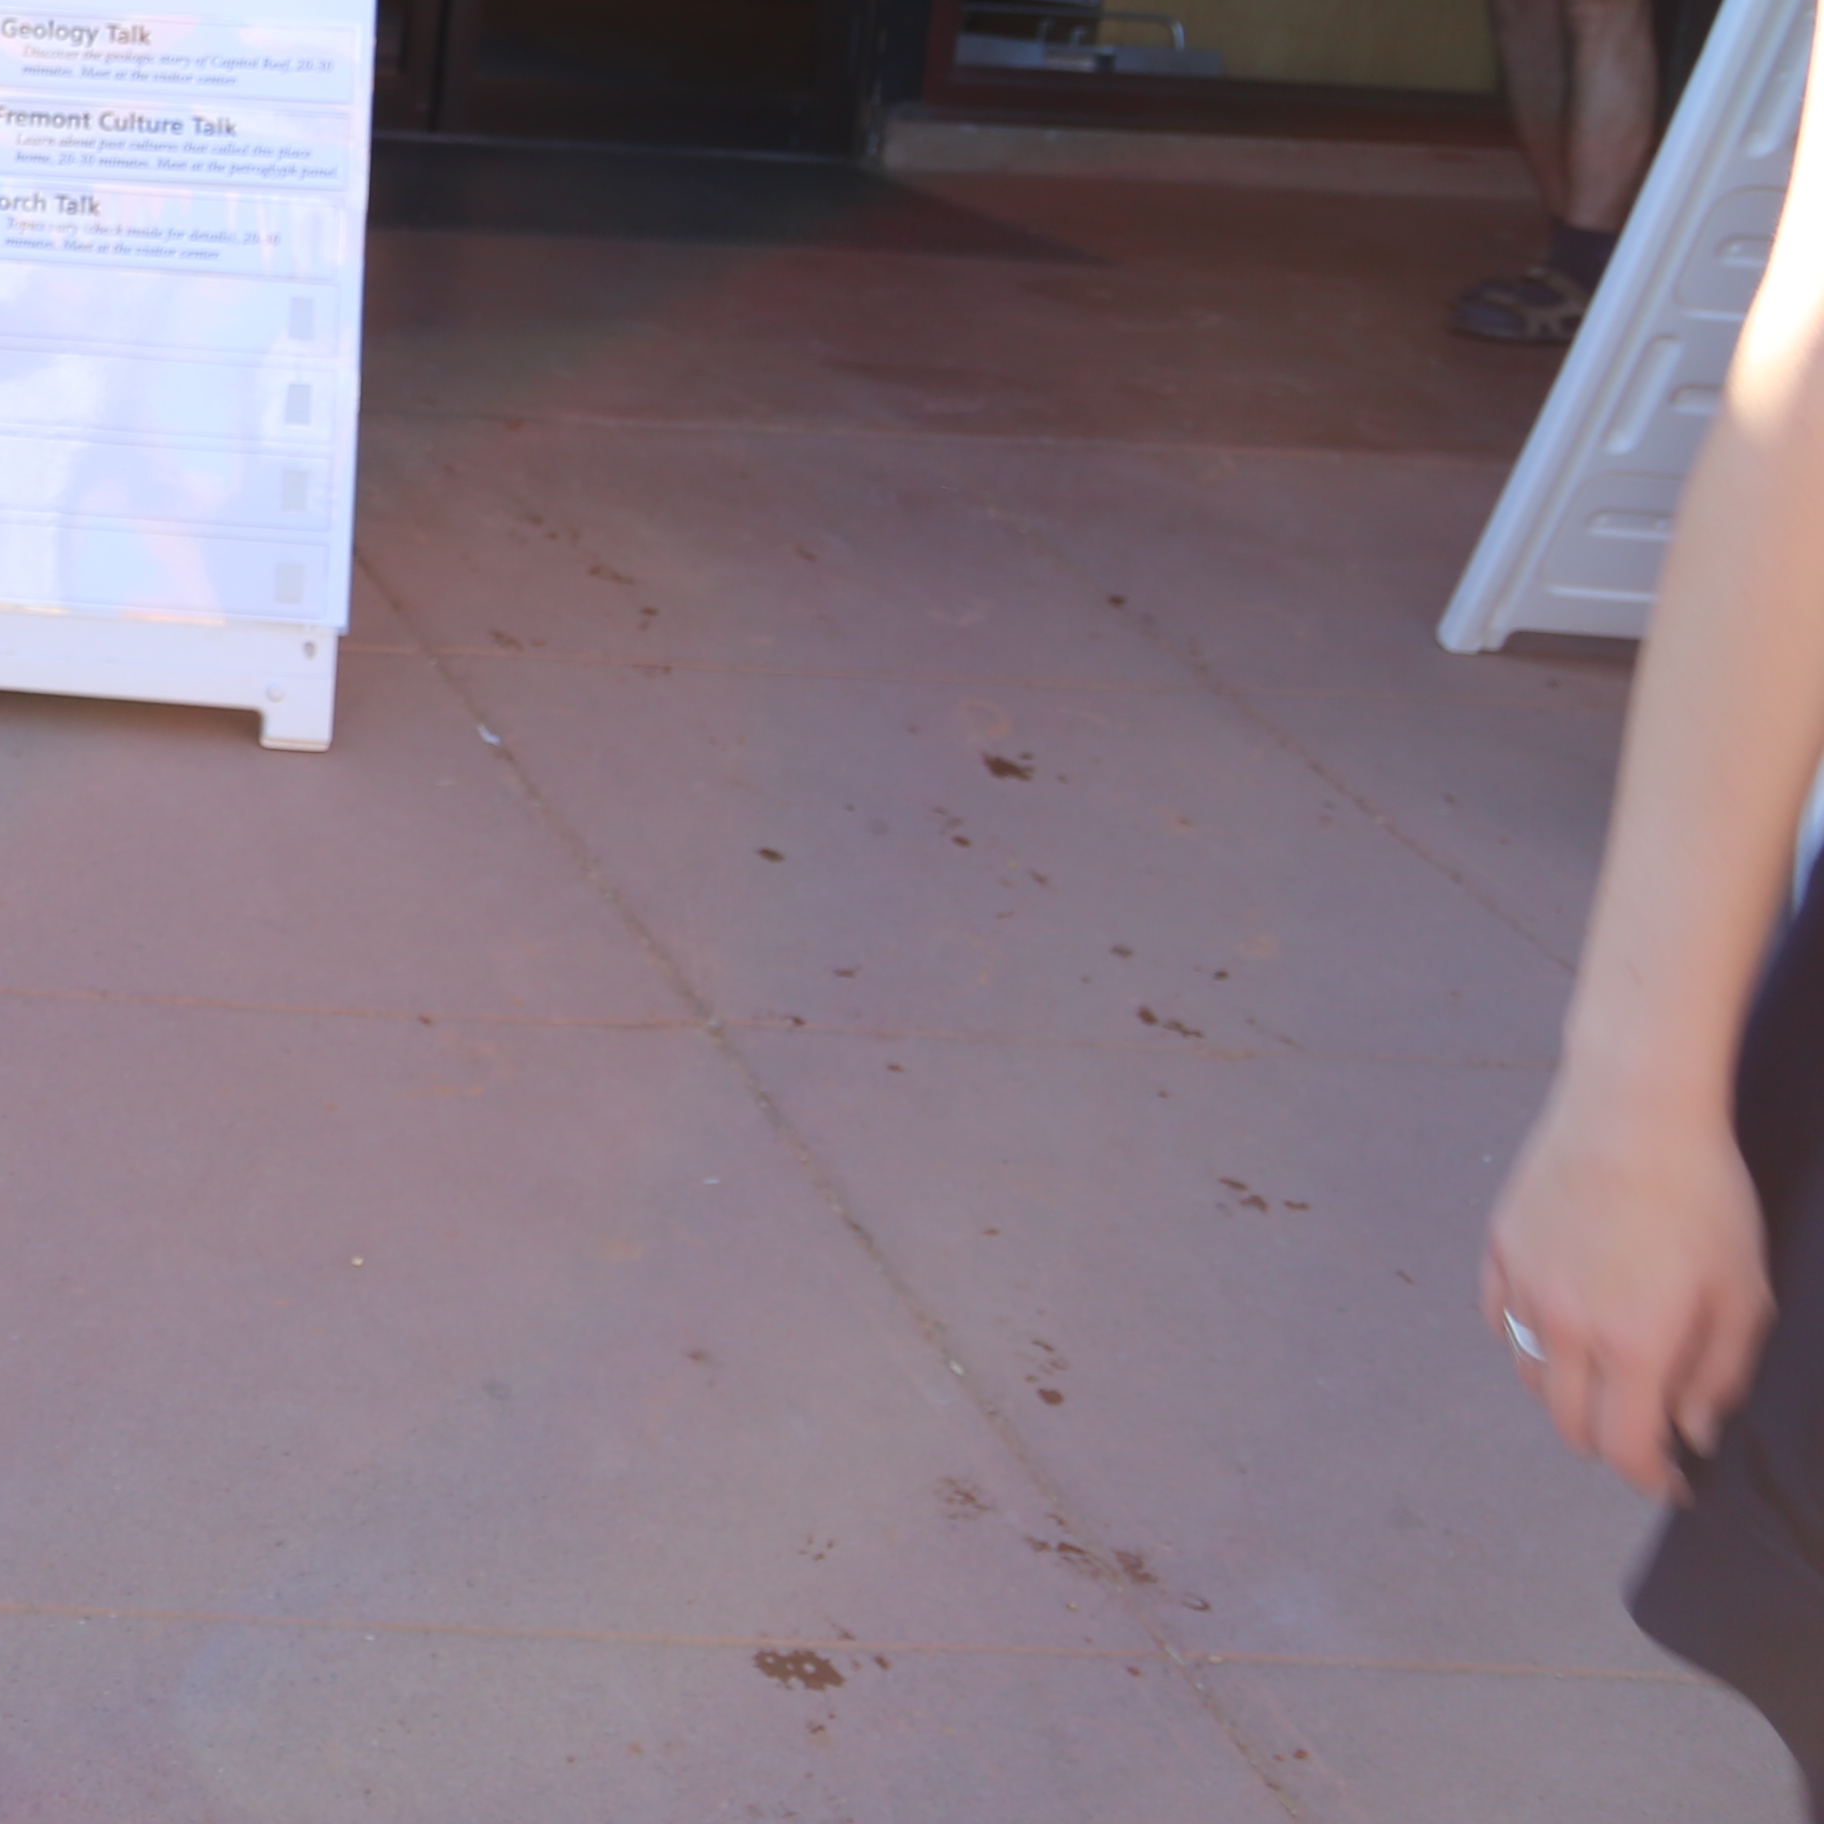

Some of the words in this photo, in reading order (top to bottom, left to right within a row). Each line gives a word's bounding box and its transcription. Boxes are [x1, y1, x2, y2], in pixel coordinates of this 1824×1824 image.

[1, 18, 100, 48] Geology
[107, 24, 153, 46] Talk
[101, 110, 184, 136] Culture
[192, 115, 238, 138] Talk
[55, 195, 102, 217] Talk
